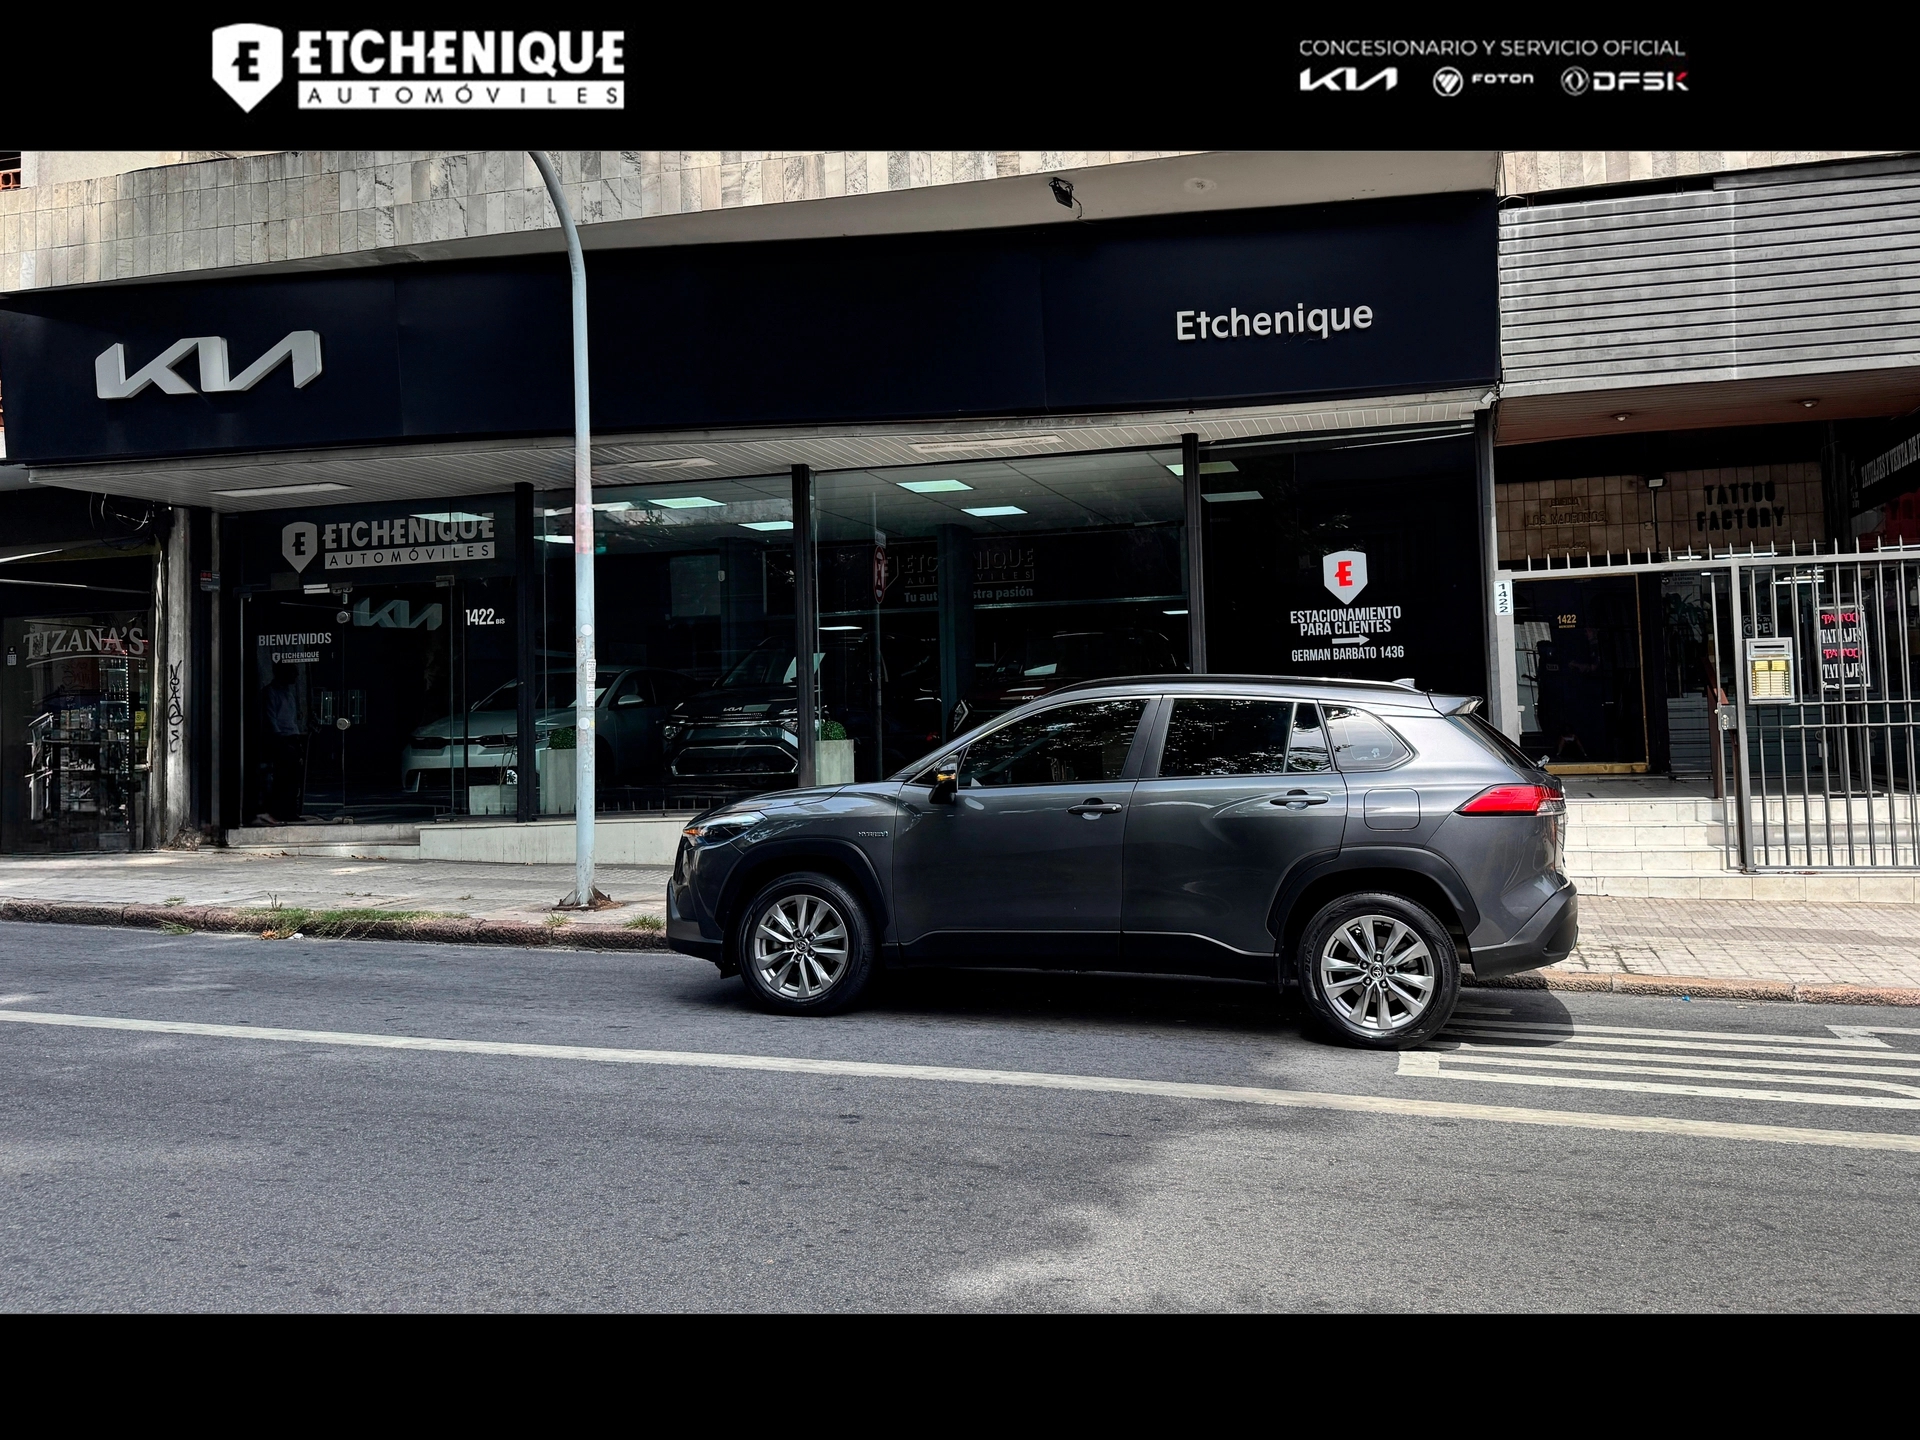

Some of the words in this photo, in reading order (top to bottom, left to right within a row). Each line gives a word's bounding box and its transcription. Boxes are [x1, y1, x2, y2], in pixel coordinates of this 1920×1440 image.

[1176, 302, 1374, 341] Etchenique
[95, 330, 323, 400] KIA
[1704, 481, 1775, 506] TATTOO
[322, 512, 494, 549] ETCHENIQUE
[1697, 507, 1785, 532] FACTORY
[329, 545, 489, 567] AUTOMÓVILES
[1497, 583, 1509, 613] 1422
[353, 597, 443, 631] KIA
[466, 608, 496, 626] 1422
[1290, 605, 1402, 625] ESTACIONAMIENTO
[1557, 614, 1577, 625] 1422
[1821, 612, 1860, 625] TATOO
[1300, 622, 1332, 636] PARA
[1334, 619, 1391, 635] CLIENTES
[23, 626, 145, 661] TIZANA'S
[258, 632, 332, 646] BIENVENIDOS
[1291, 648, 1331, 662] GERMAN
[1333, 646, 1377, 660] BARBATO
[1380, 645, 1404, 659] 1436
[1823, 648, 1863, 661] TATOO
